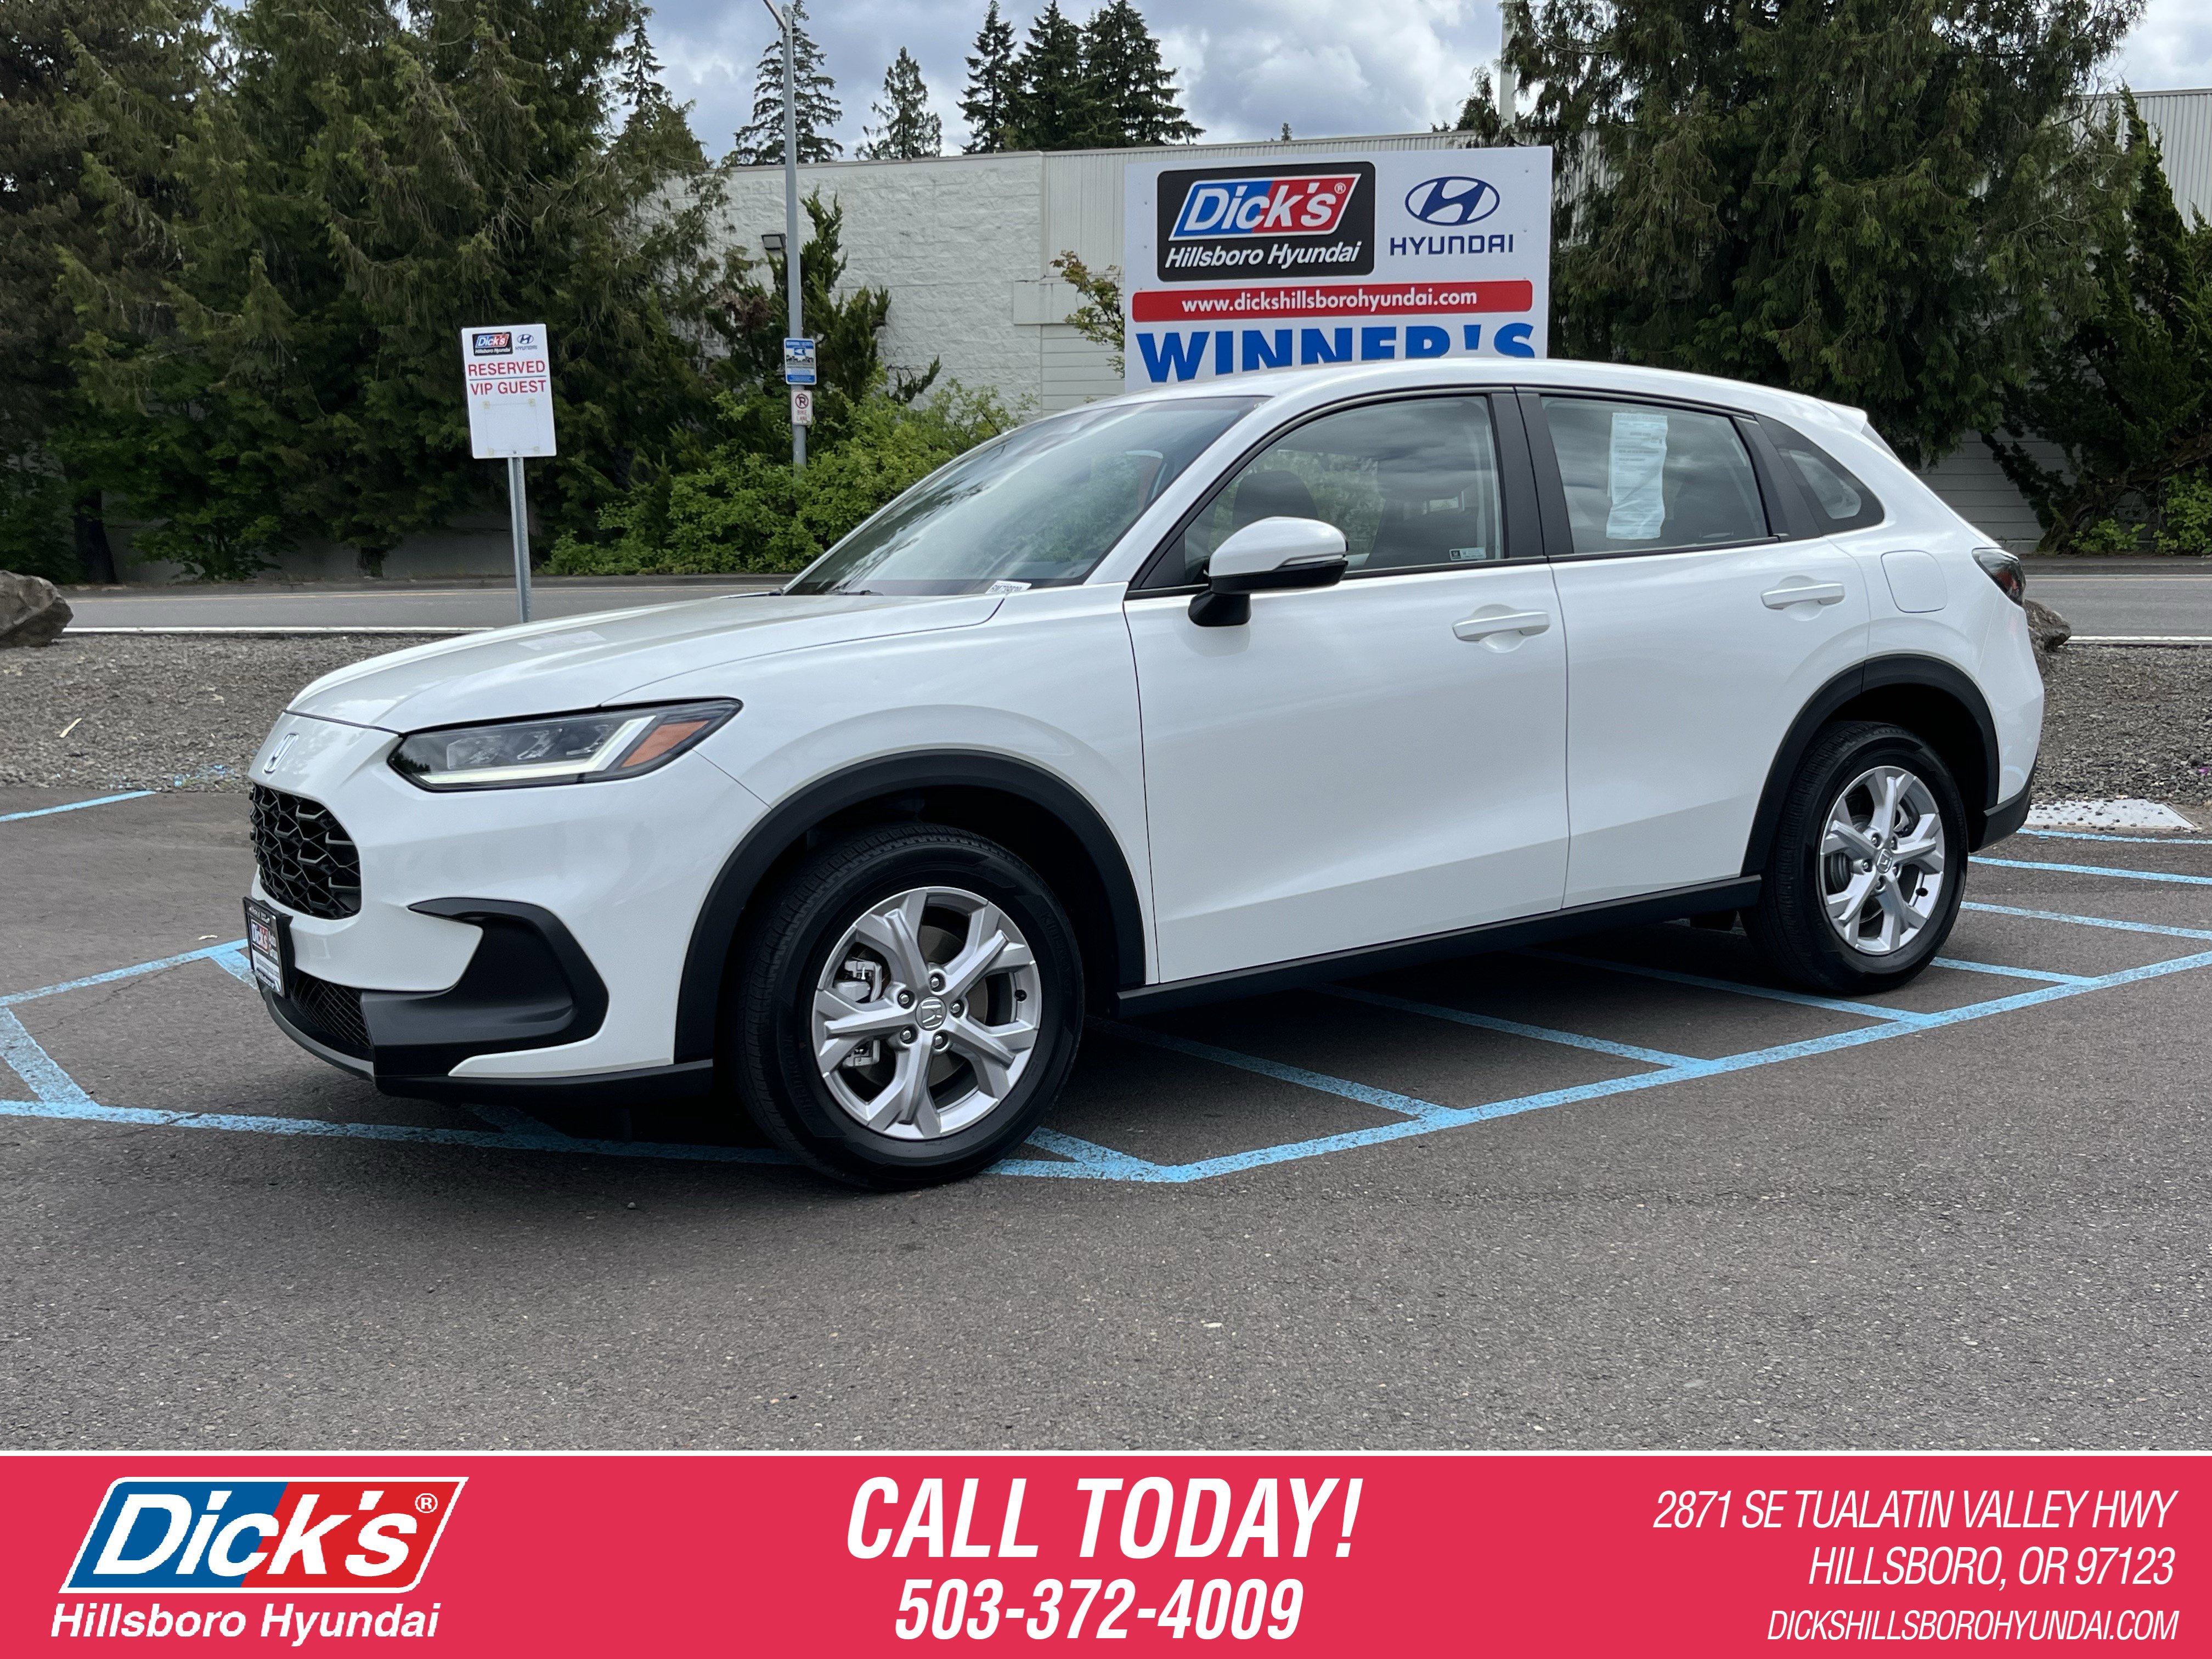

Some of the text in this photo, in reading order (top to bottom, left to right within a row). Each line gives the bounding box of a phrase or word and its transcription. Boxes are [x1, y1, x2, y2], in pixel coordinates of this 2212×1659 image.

[1183, 182, 1336, 231] Dick's
[1165, 241, 1362, 270] Hillsboro Hyundai
[1390, 234, 1514, 256] HYUNDAI
[1182, 287, 1477, 313] www.dickshillsborohyundai.com
[468, 360, 545, 376] RESERVED
[470, 380, 546, 395] VIP GUEST
